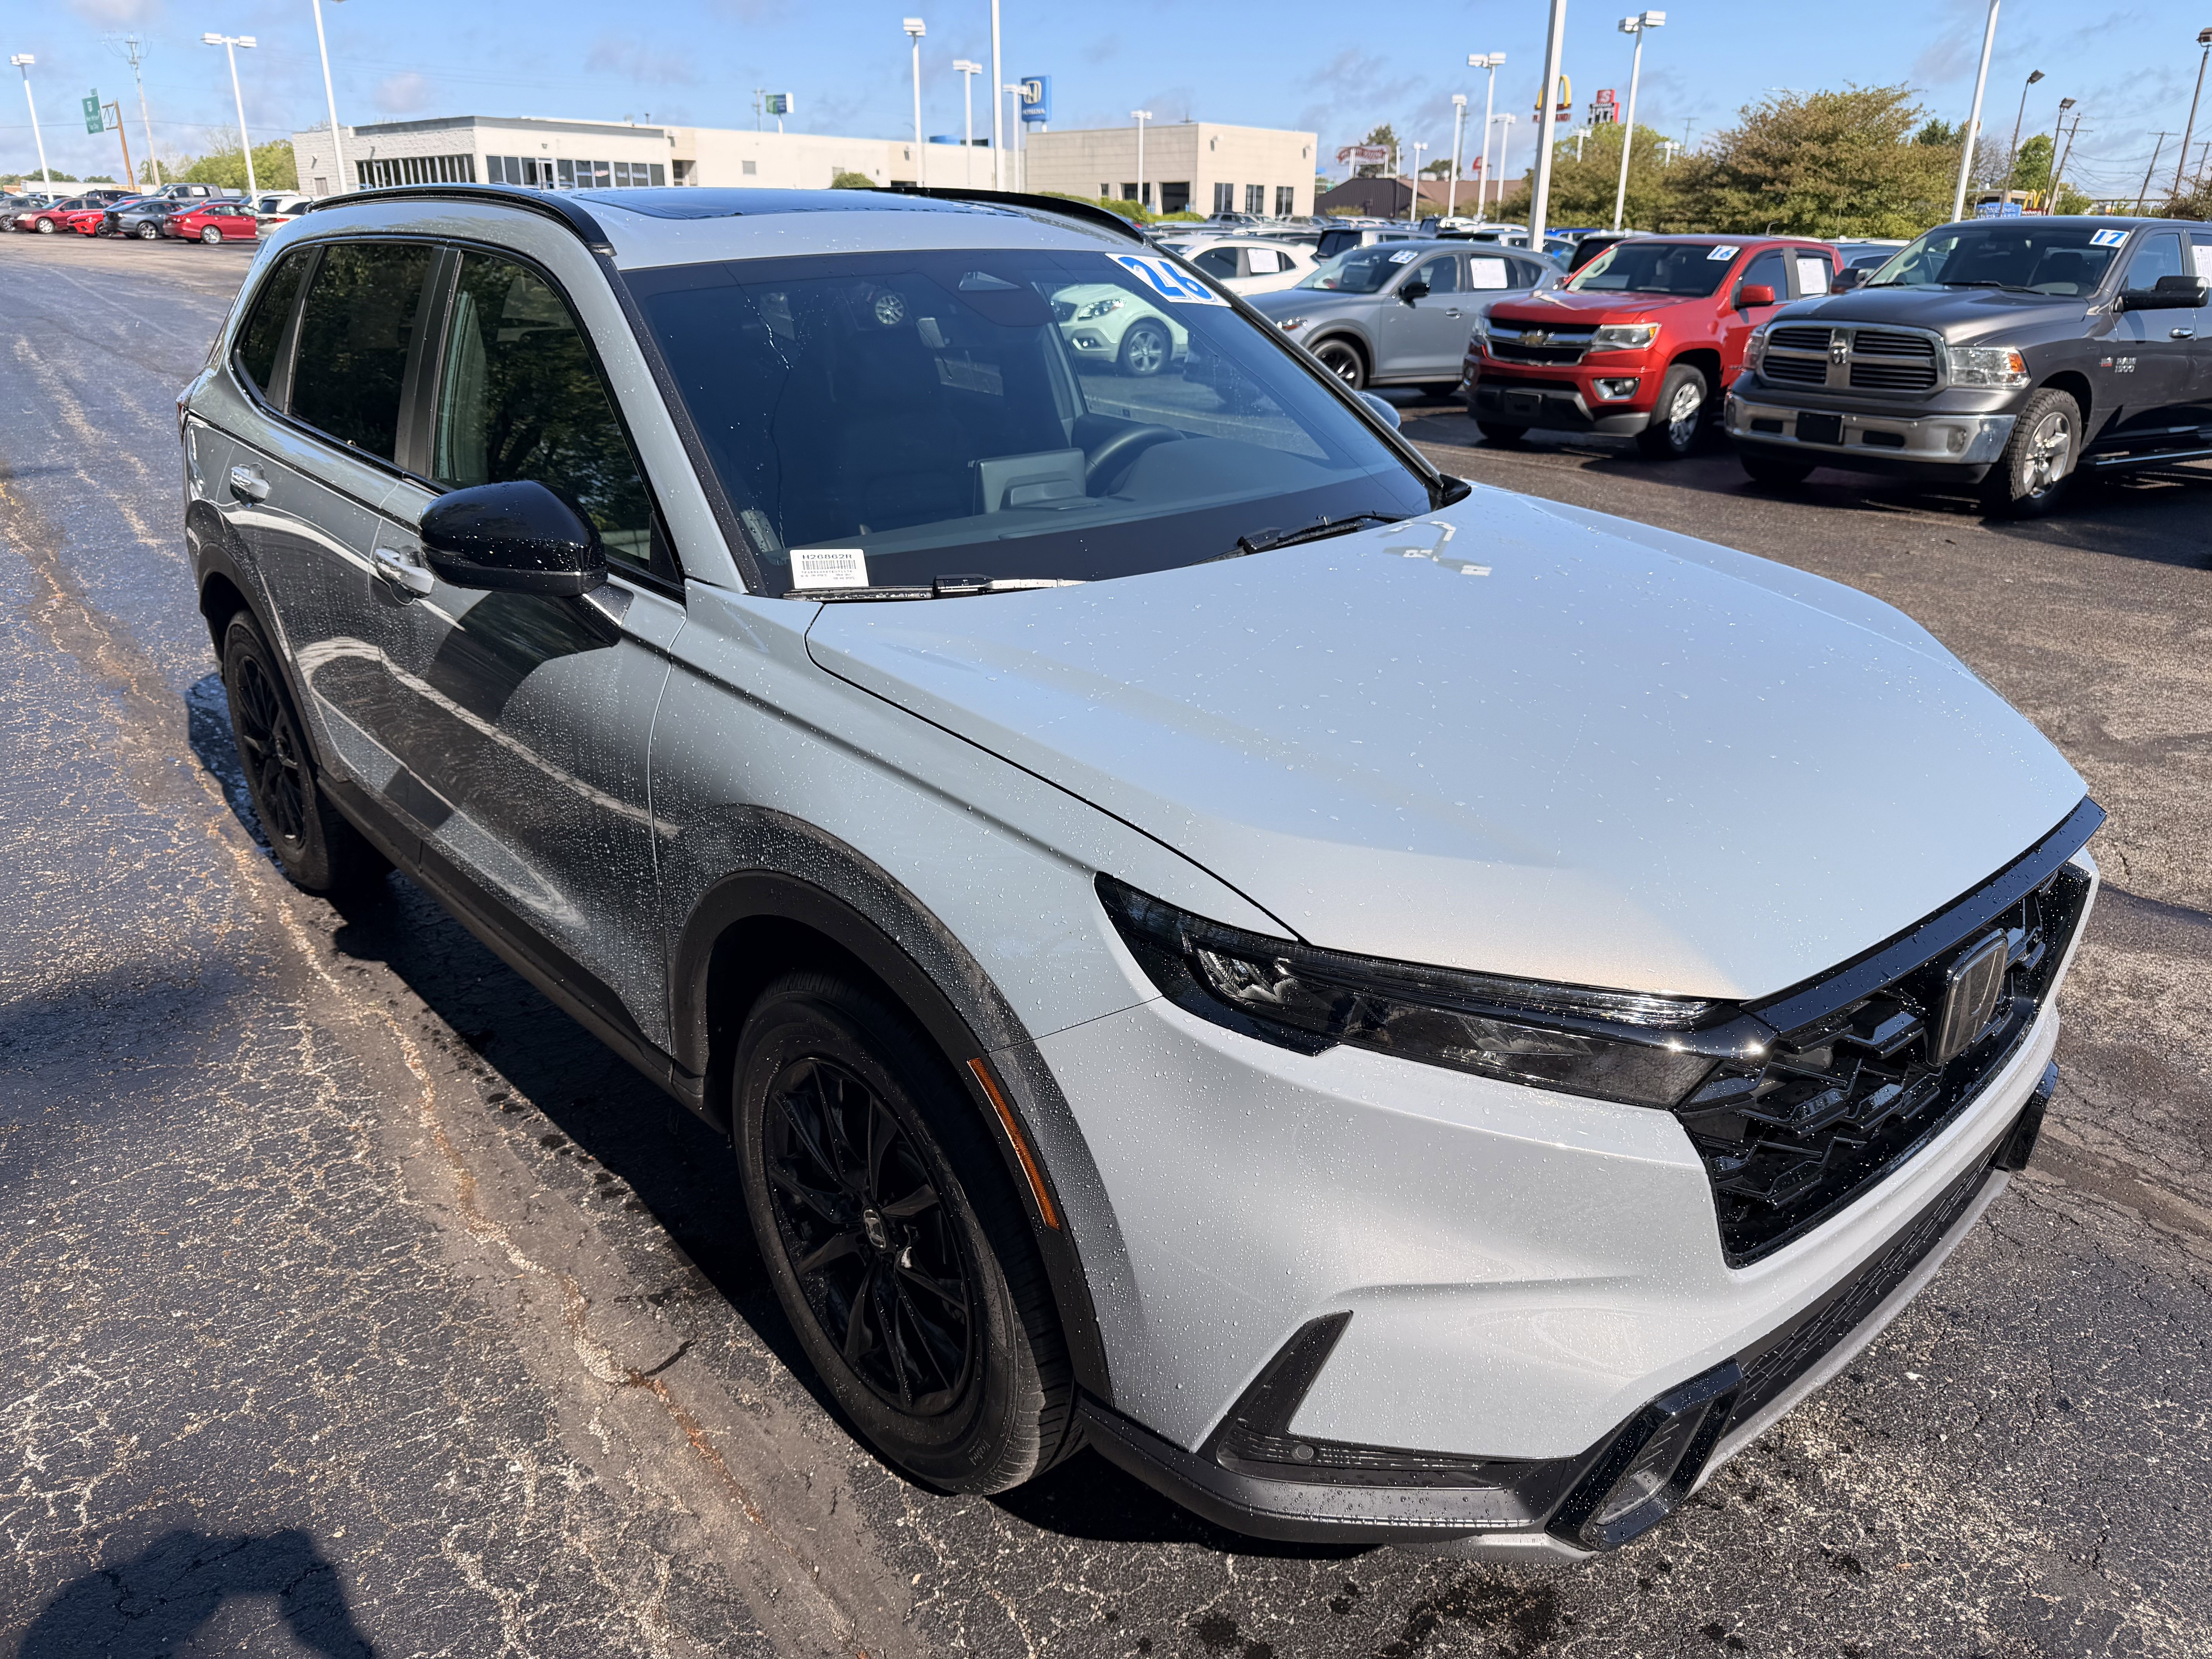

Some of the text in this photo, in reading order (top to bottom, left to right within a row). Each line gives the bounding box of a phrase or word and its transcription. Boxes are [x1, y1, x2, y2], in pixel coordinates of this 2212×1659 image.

[2094, 231, 2125, 244] 17
[1711, 247, 1734, 259] 16
[1118, 256, 1212, 300] 26
[2116, 357, 2137, 365] RAM
